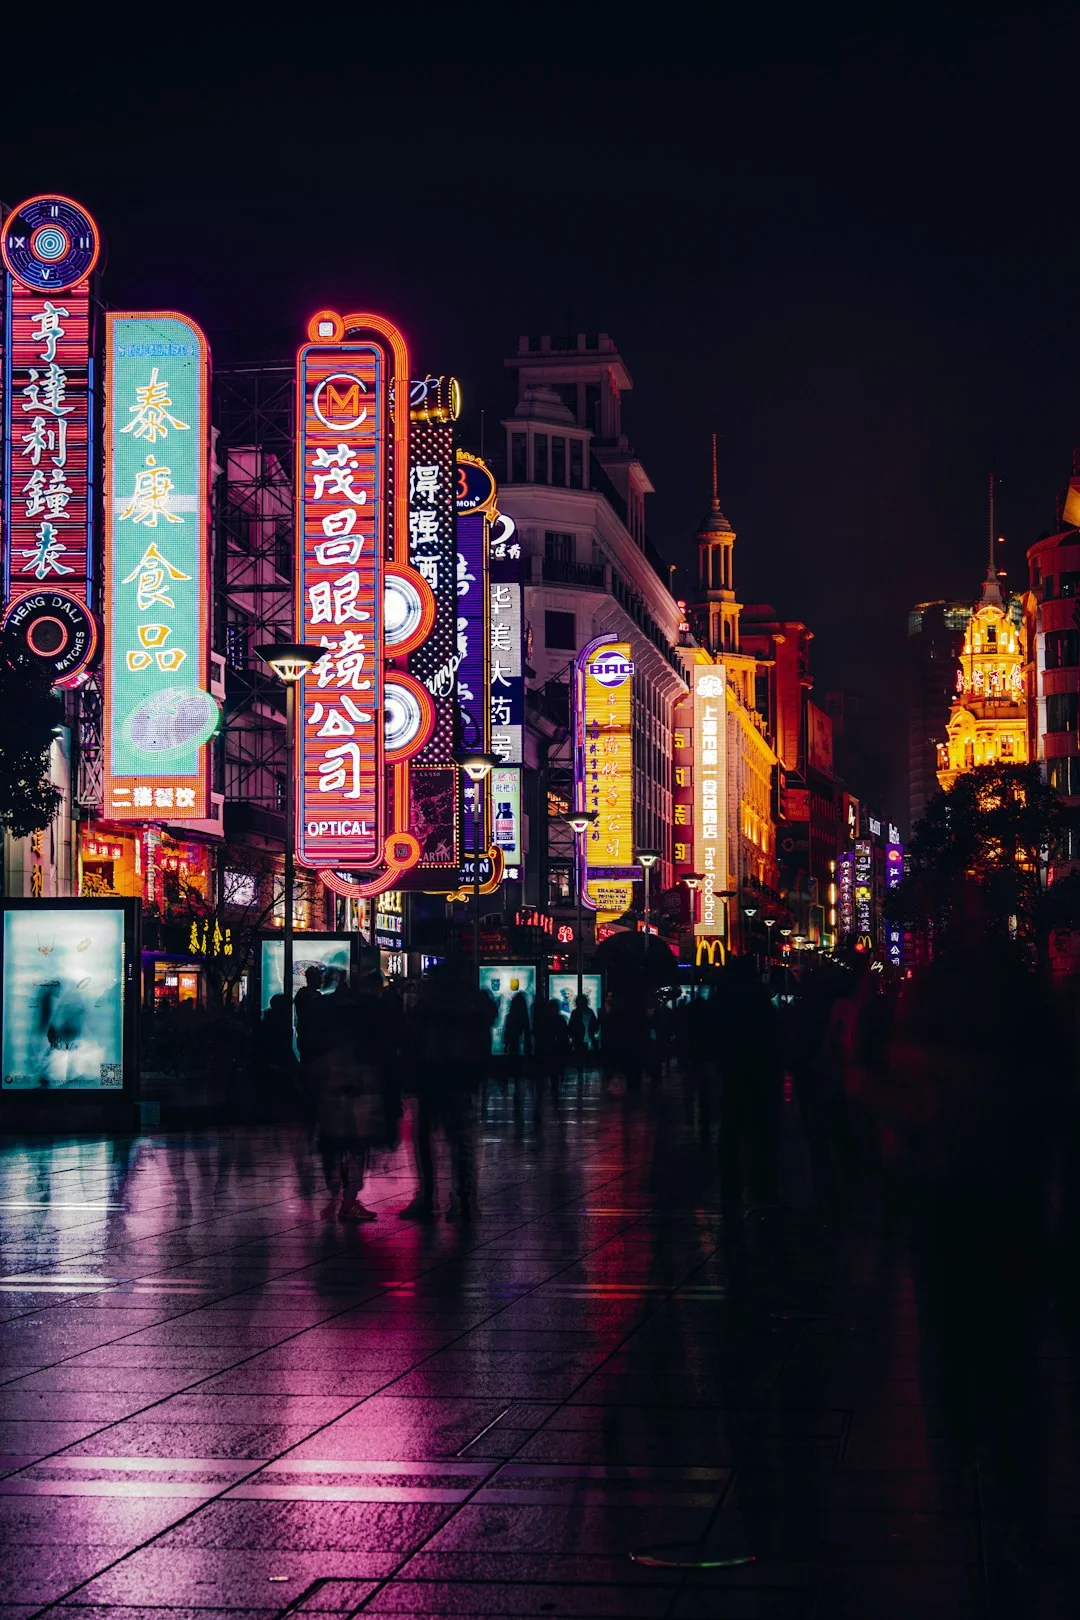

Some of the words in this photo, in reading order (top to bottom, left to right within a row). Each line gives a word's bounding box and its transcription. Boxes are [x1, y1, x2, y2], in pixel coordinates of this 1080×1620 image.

[119, 367, 192, 672] 泰康食品
[10, 596, 46, 627] HENG
[52, 596, 83, 624] DALI
[308, 443, 372, 799] 茂昌眼镜公司
[55, 631, 85, 671] WATCHES
[589, 663, 634, 675] BAC
[307, 820, 371, 837] OPTICAL
[704, 847, 716, 870] First
[704, 873, 716, 926] Foodhall
